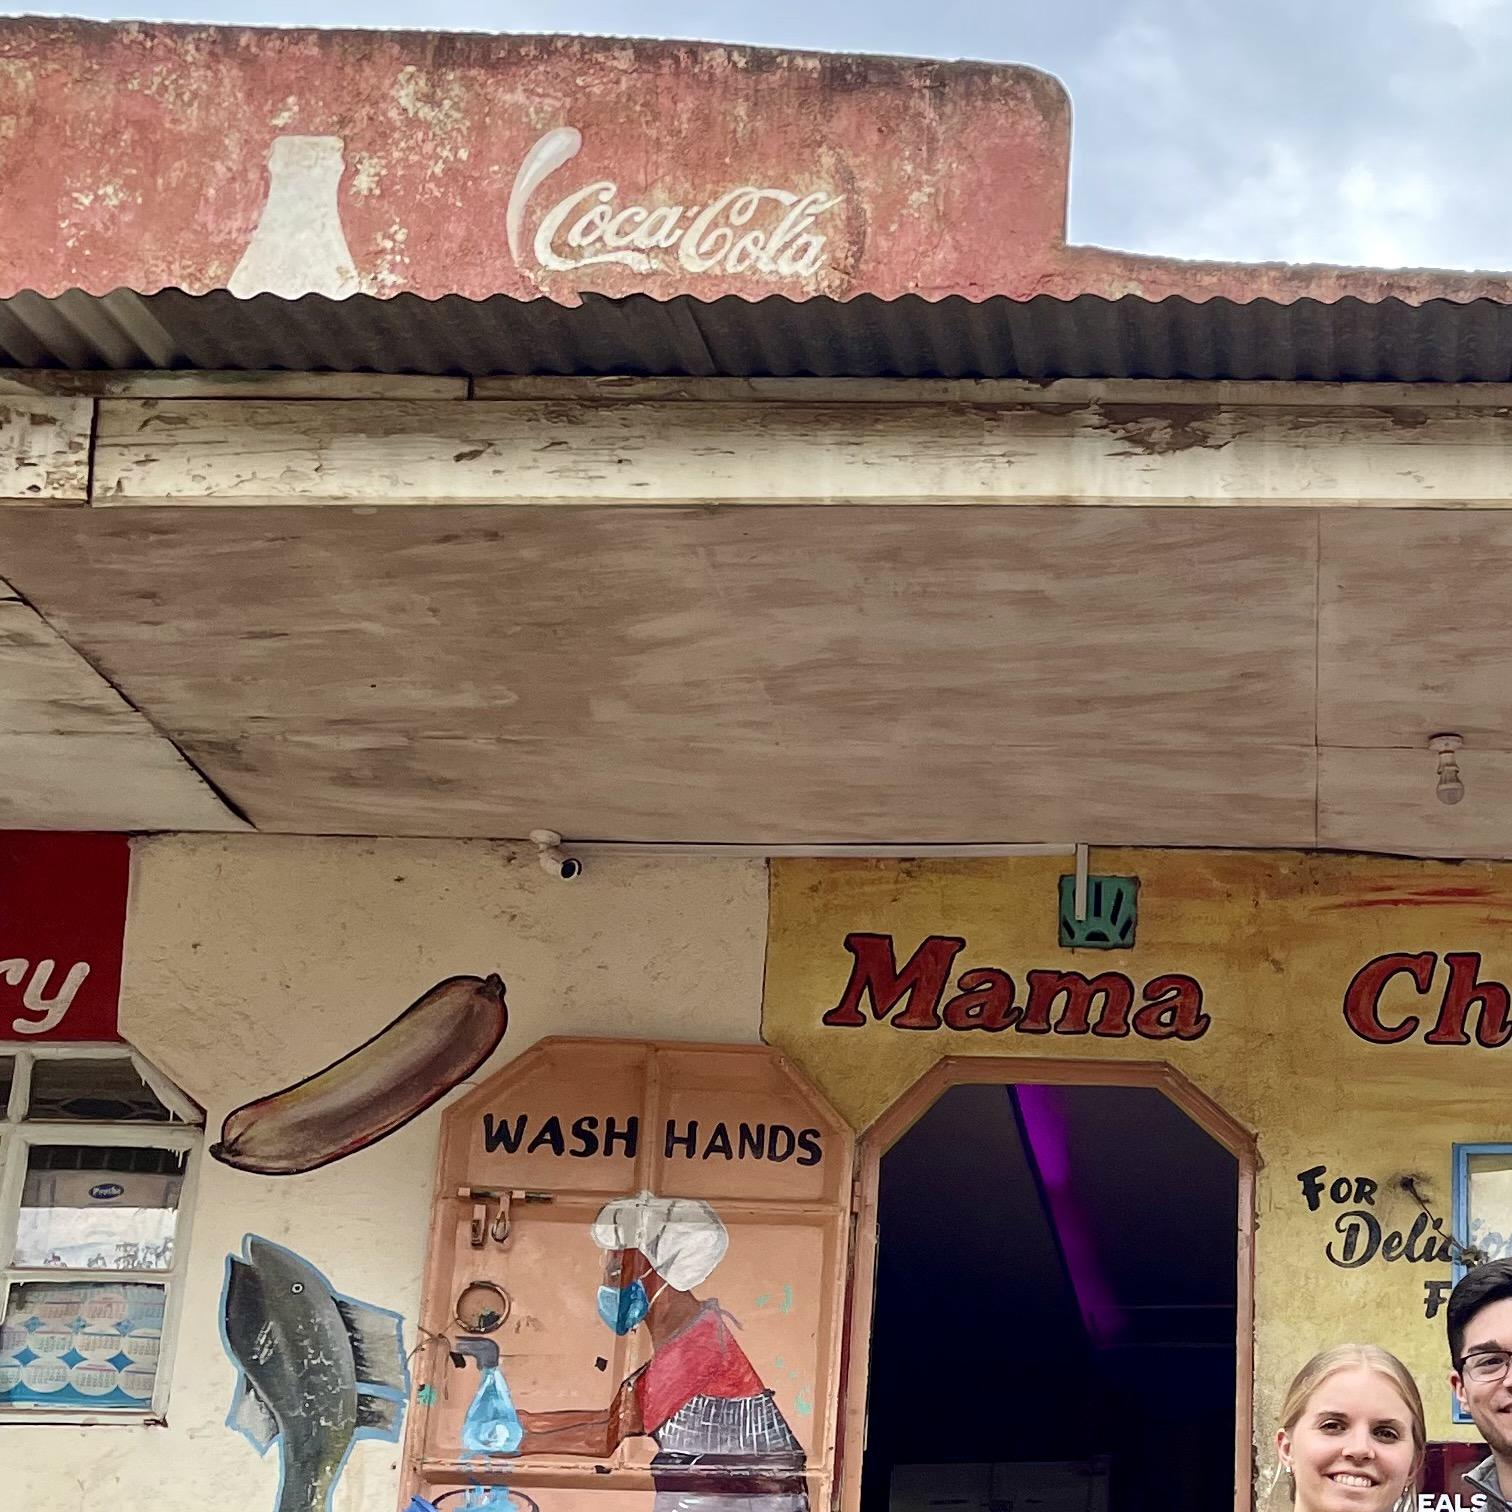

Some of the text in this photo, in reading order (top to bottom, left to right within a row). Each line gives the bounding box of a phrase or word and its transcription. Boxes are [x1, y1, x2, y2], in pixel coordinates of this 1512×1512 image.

[822, 932, 1212, 1041] Mama
[483, 1113, 823, 1166] WASH HANDS
